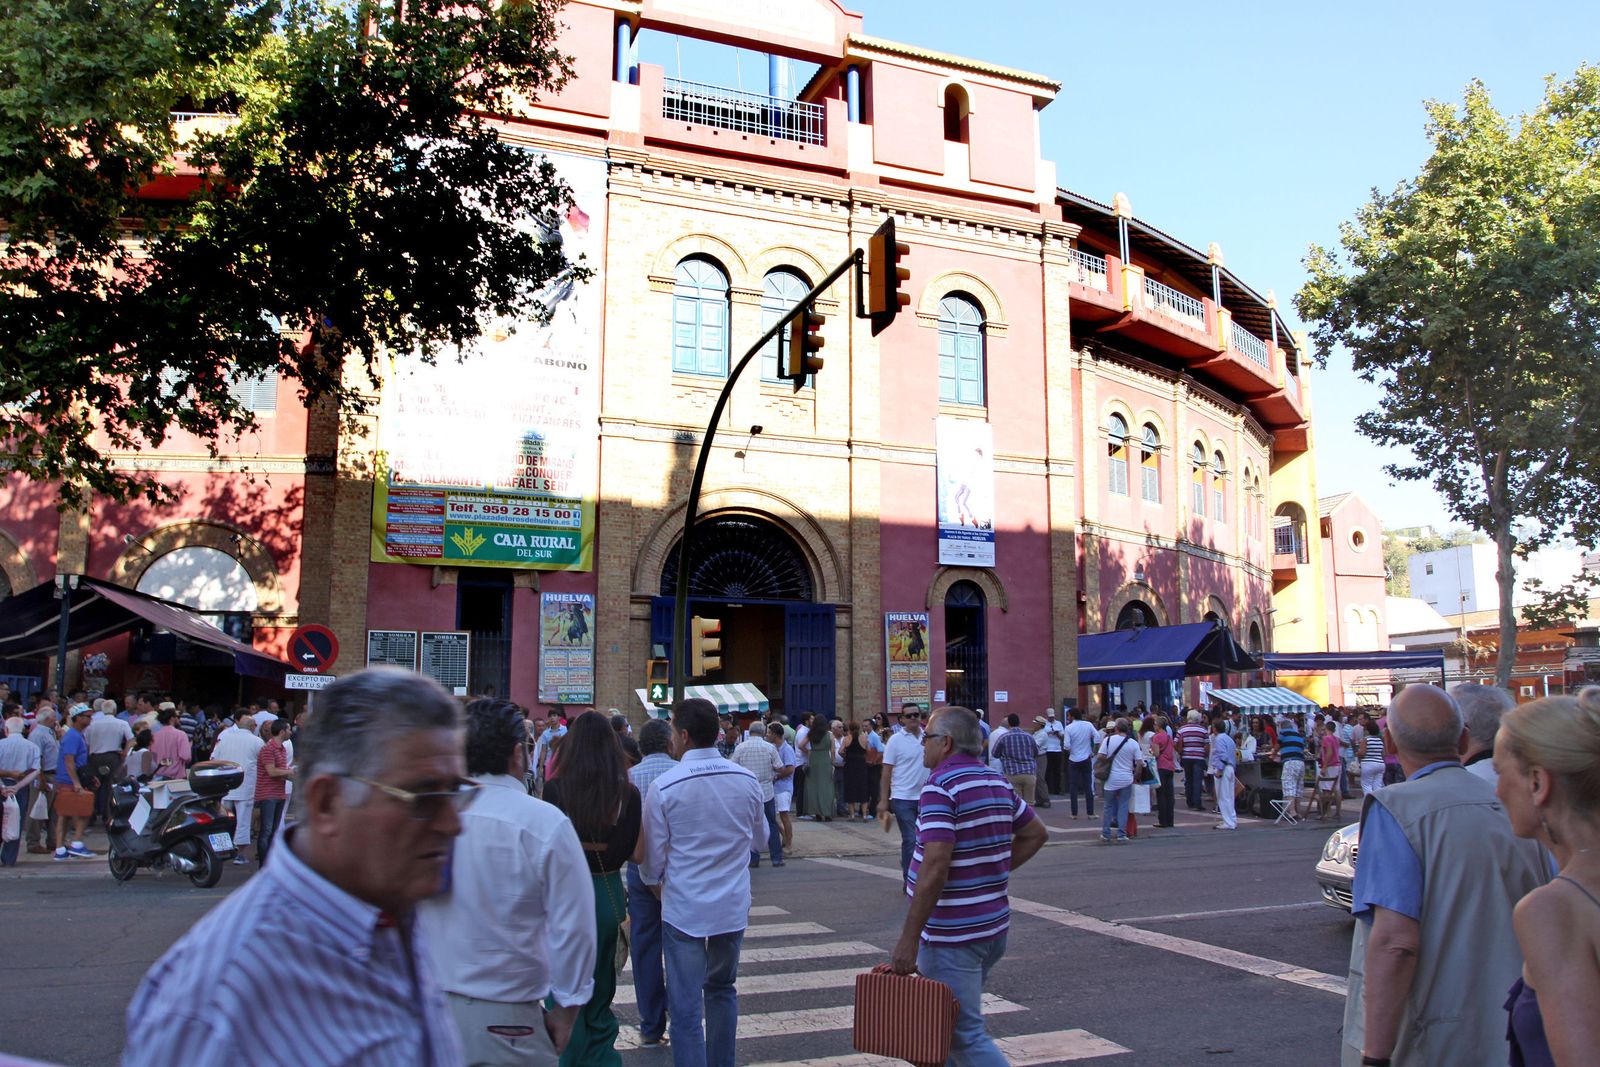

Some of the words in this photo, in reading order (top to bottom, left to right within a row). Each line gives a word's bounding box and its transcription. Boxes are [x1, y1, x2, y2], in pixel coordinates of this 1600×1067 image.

[534, 356, 588, 371] ABONO
[526, 455, 538, 467] DE
[540, 456, 574, 470] MIRAND
[496, 476, 539, 490] RAFAEL
[447, 495, 504, 504] ABONOS
[507, 499, 549, 508] DESDE
[448, 503, 478, 513] Telf.
[482, 505, 509, 515] 959
[513, 507, 530, 516] 28
[534, 508, 550, 518] 15
[554, 510, 571, 519] 00
[449, 512, 570, 526] www.plazadetorosdehuelva.es
[493, 533, 528, 548] CAJA
[530, 535, 576, 550] RURAL
[516, 548, 533, 557] DEL
[534, 550, 552, 559] SUR
[545, 593, 592, 602] HUELVA
[288, 675, 319, 683] EXCEPTO
